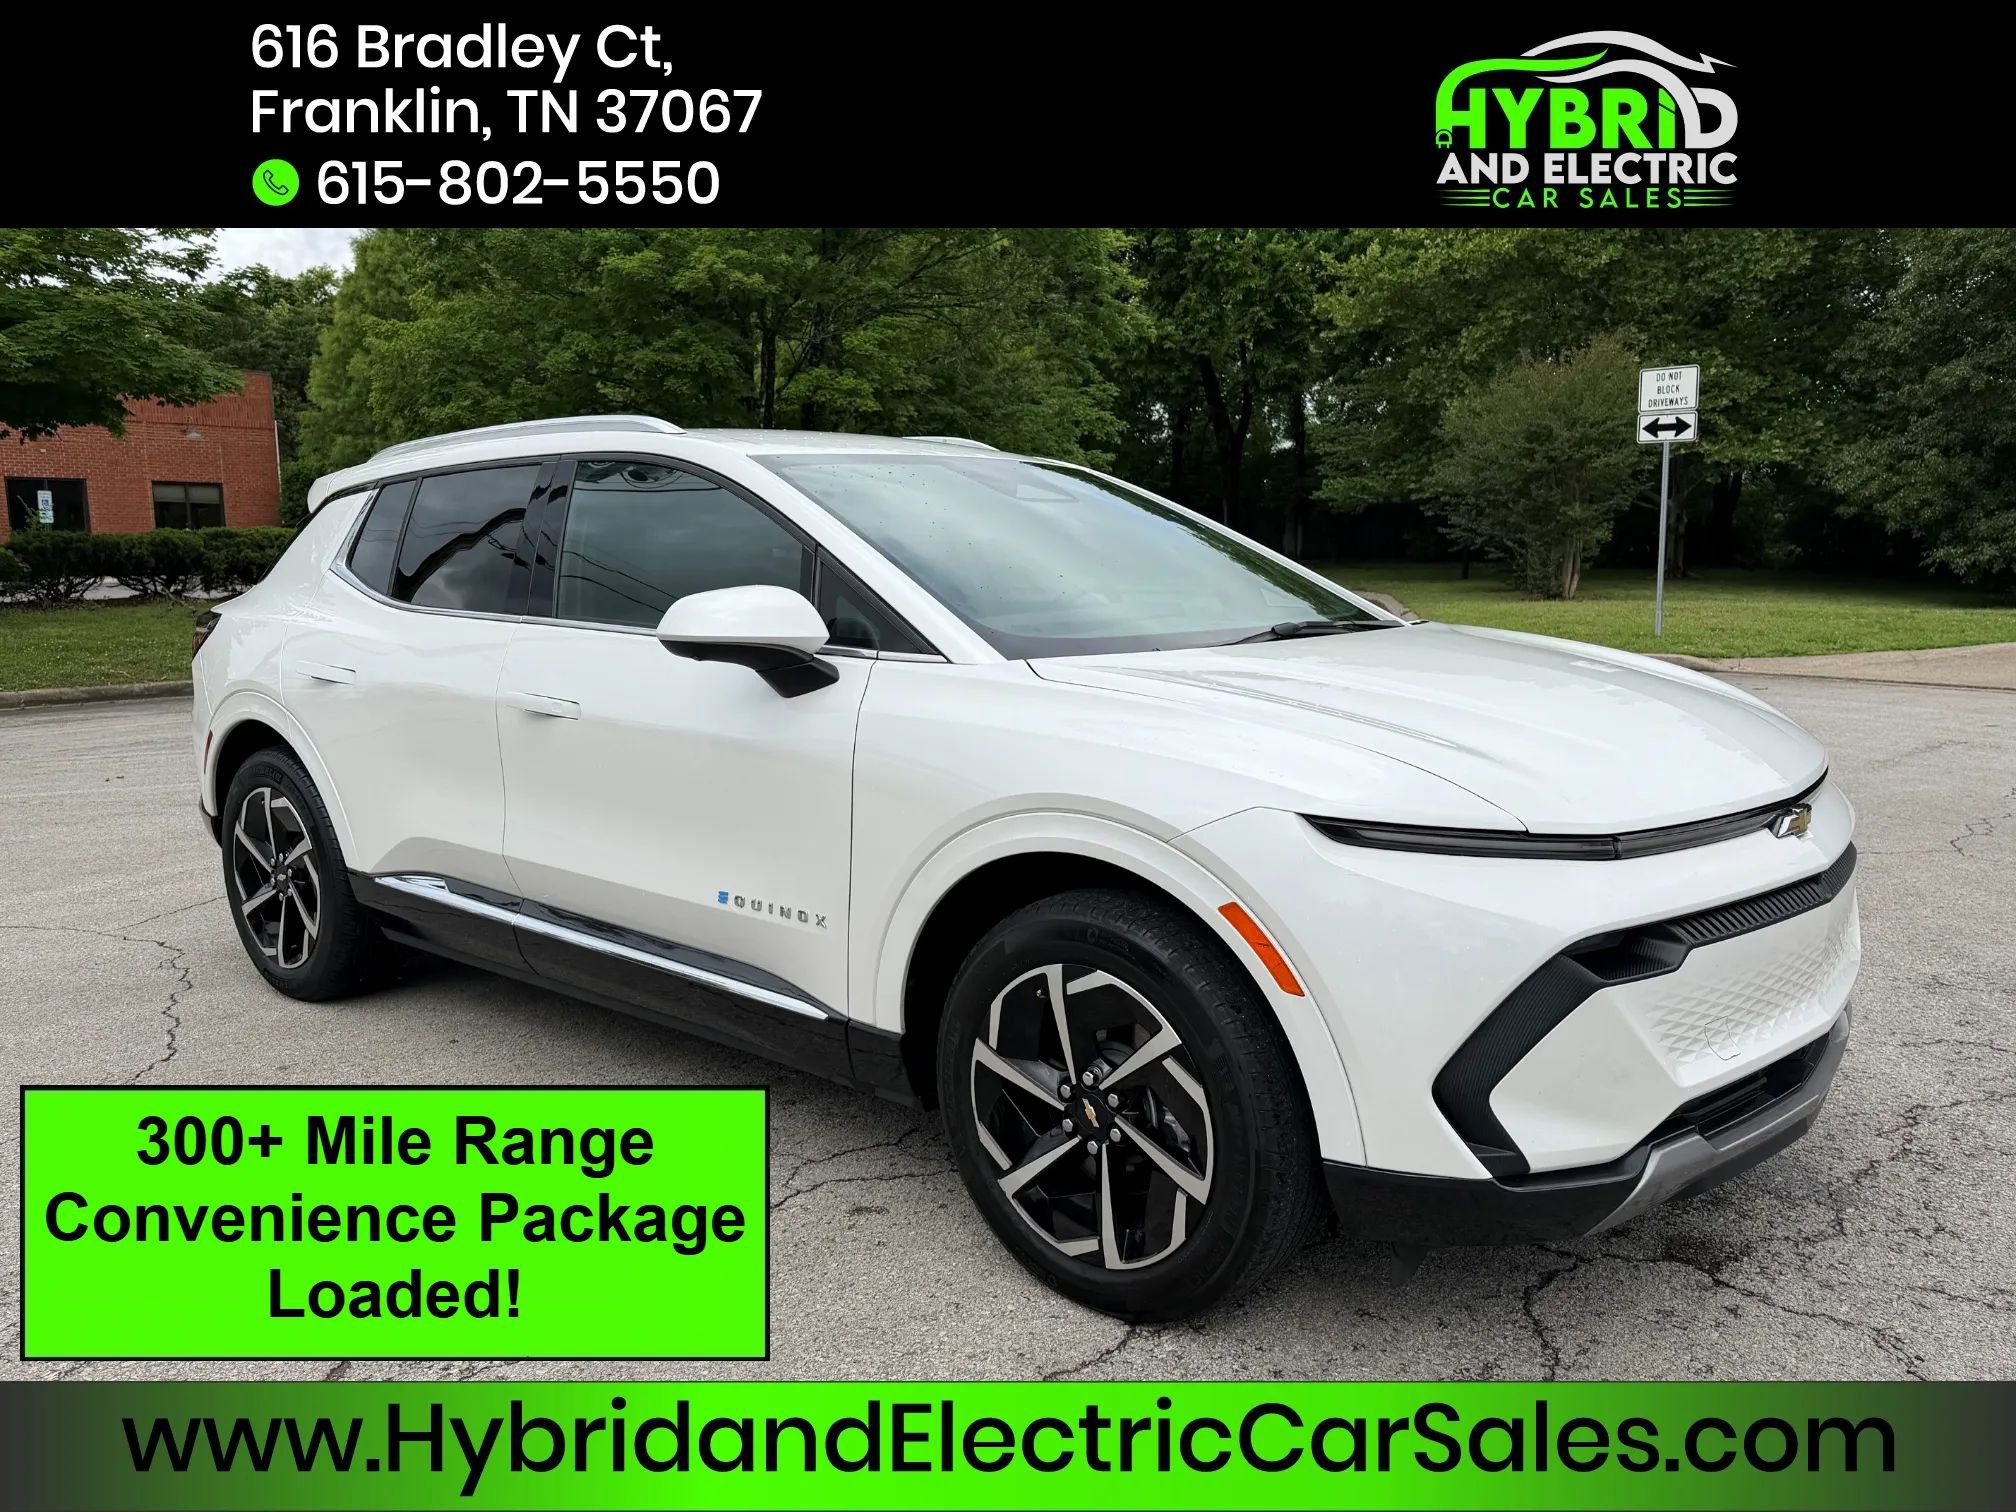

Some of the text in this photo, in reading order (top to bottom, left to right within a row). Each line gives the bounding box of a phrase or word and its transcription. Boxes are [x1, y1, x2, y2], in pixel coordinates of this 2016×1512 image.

[1656, 371, 1682, 382] DO NOT
[1657, 384, 1680, 395] BLOCK
[1648, 396, 1689, 408] DRIVEWAYS
[717, 890, 828, 929] EQUINOX
